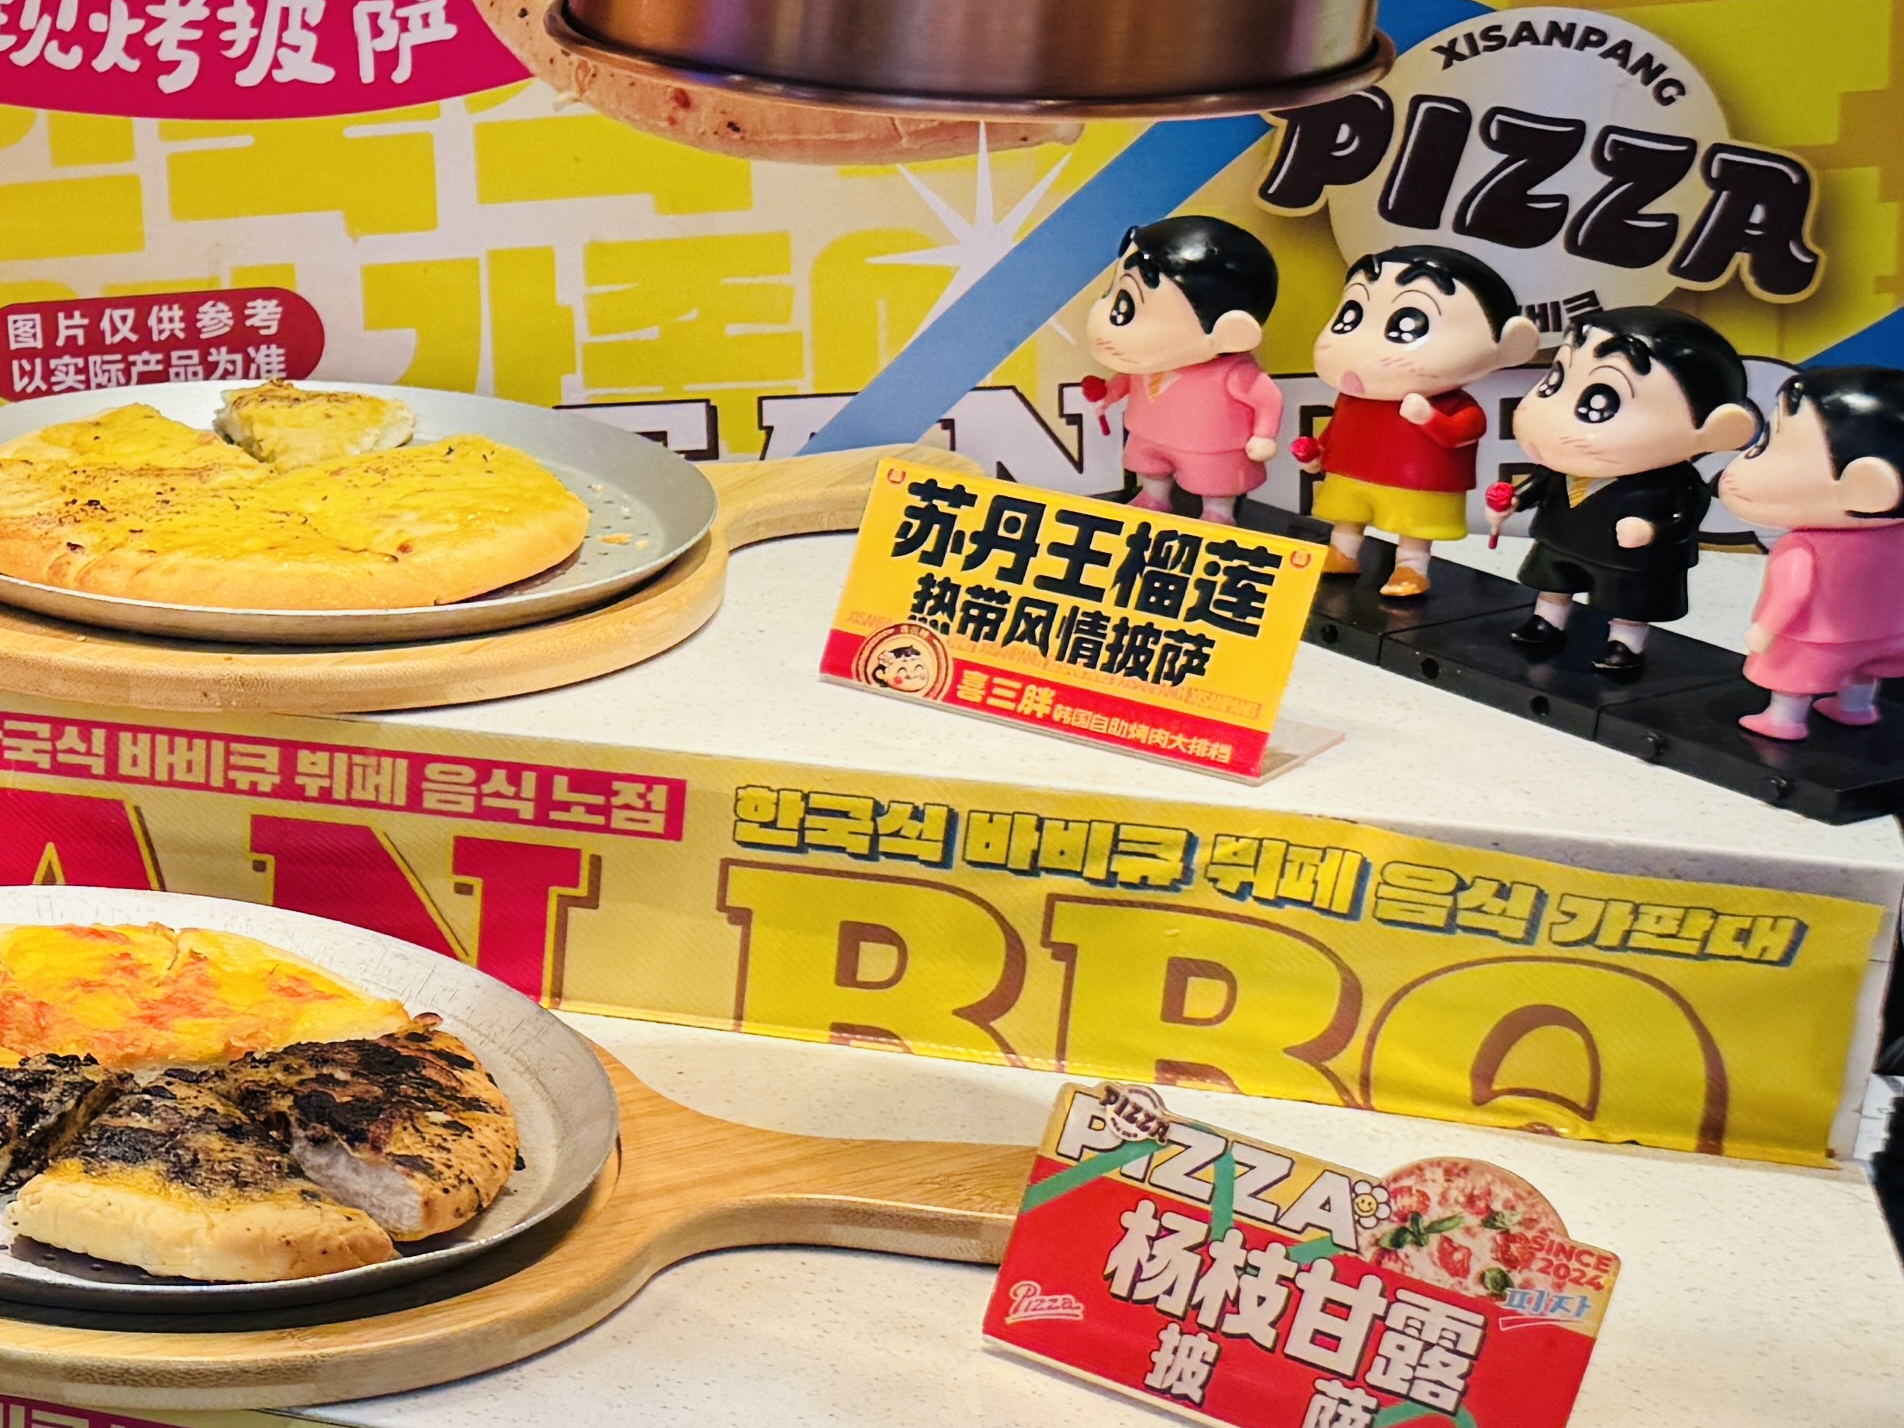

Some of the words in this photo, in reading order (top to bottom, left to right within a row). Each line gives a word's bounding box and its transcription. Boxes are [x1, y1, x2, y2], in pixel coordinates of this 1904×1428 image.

[1430, 18, 1688, 108] XISANPANG
[1258, 84, 1822, 299] PIZZA
[5, 298, 284, 353] 图片仅供参考
[10, 342, 289, 396] 以实际产品为准
[891, 476, 1285, 638] 苏丹王榴莲
[906, 571, 1216, 689] 热带风情披萨
[955, 670, 1057, 719] 喜三胖
[1052, 703, 1233, 765] 韩国自助烤肉大排档
[116, 728, 282, 795] 바비큐
[296, 748, 408, 811] 뷔페
[420, 764, 537, 824] 음식
[550, 779, 670, 835] 노점
[731, 783, 964, 872] 한국식
[964, 808, 1203, 892] 바비큐
[1205, 832, 1374, 922] 뷔페
[1374, 860, 1550, 948] 음식
[1549, 890, 1813, 972] 가판대
[1099, 1085, 1171, 1146] PIZZA
[1007, 1280, 1085, 1314] Pizza
[1529, 1235, 1615, 1273] SINCE
[1535, 1255, 1609, 1292] 2024
[1103, 1198, 1487, 1415] 杨枝甘露
[1503, 1286, 1593, 1320] 피자
